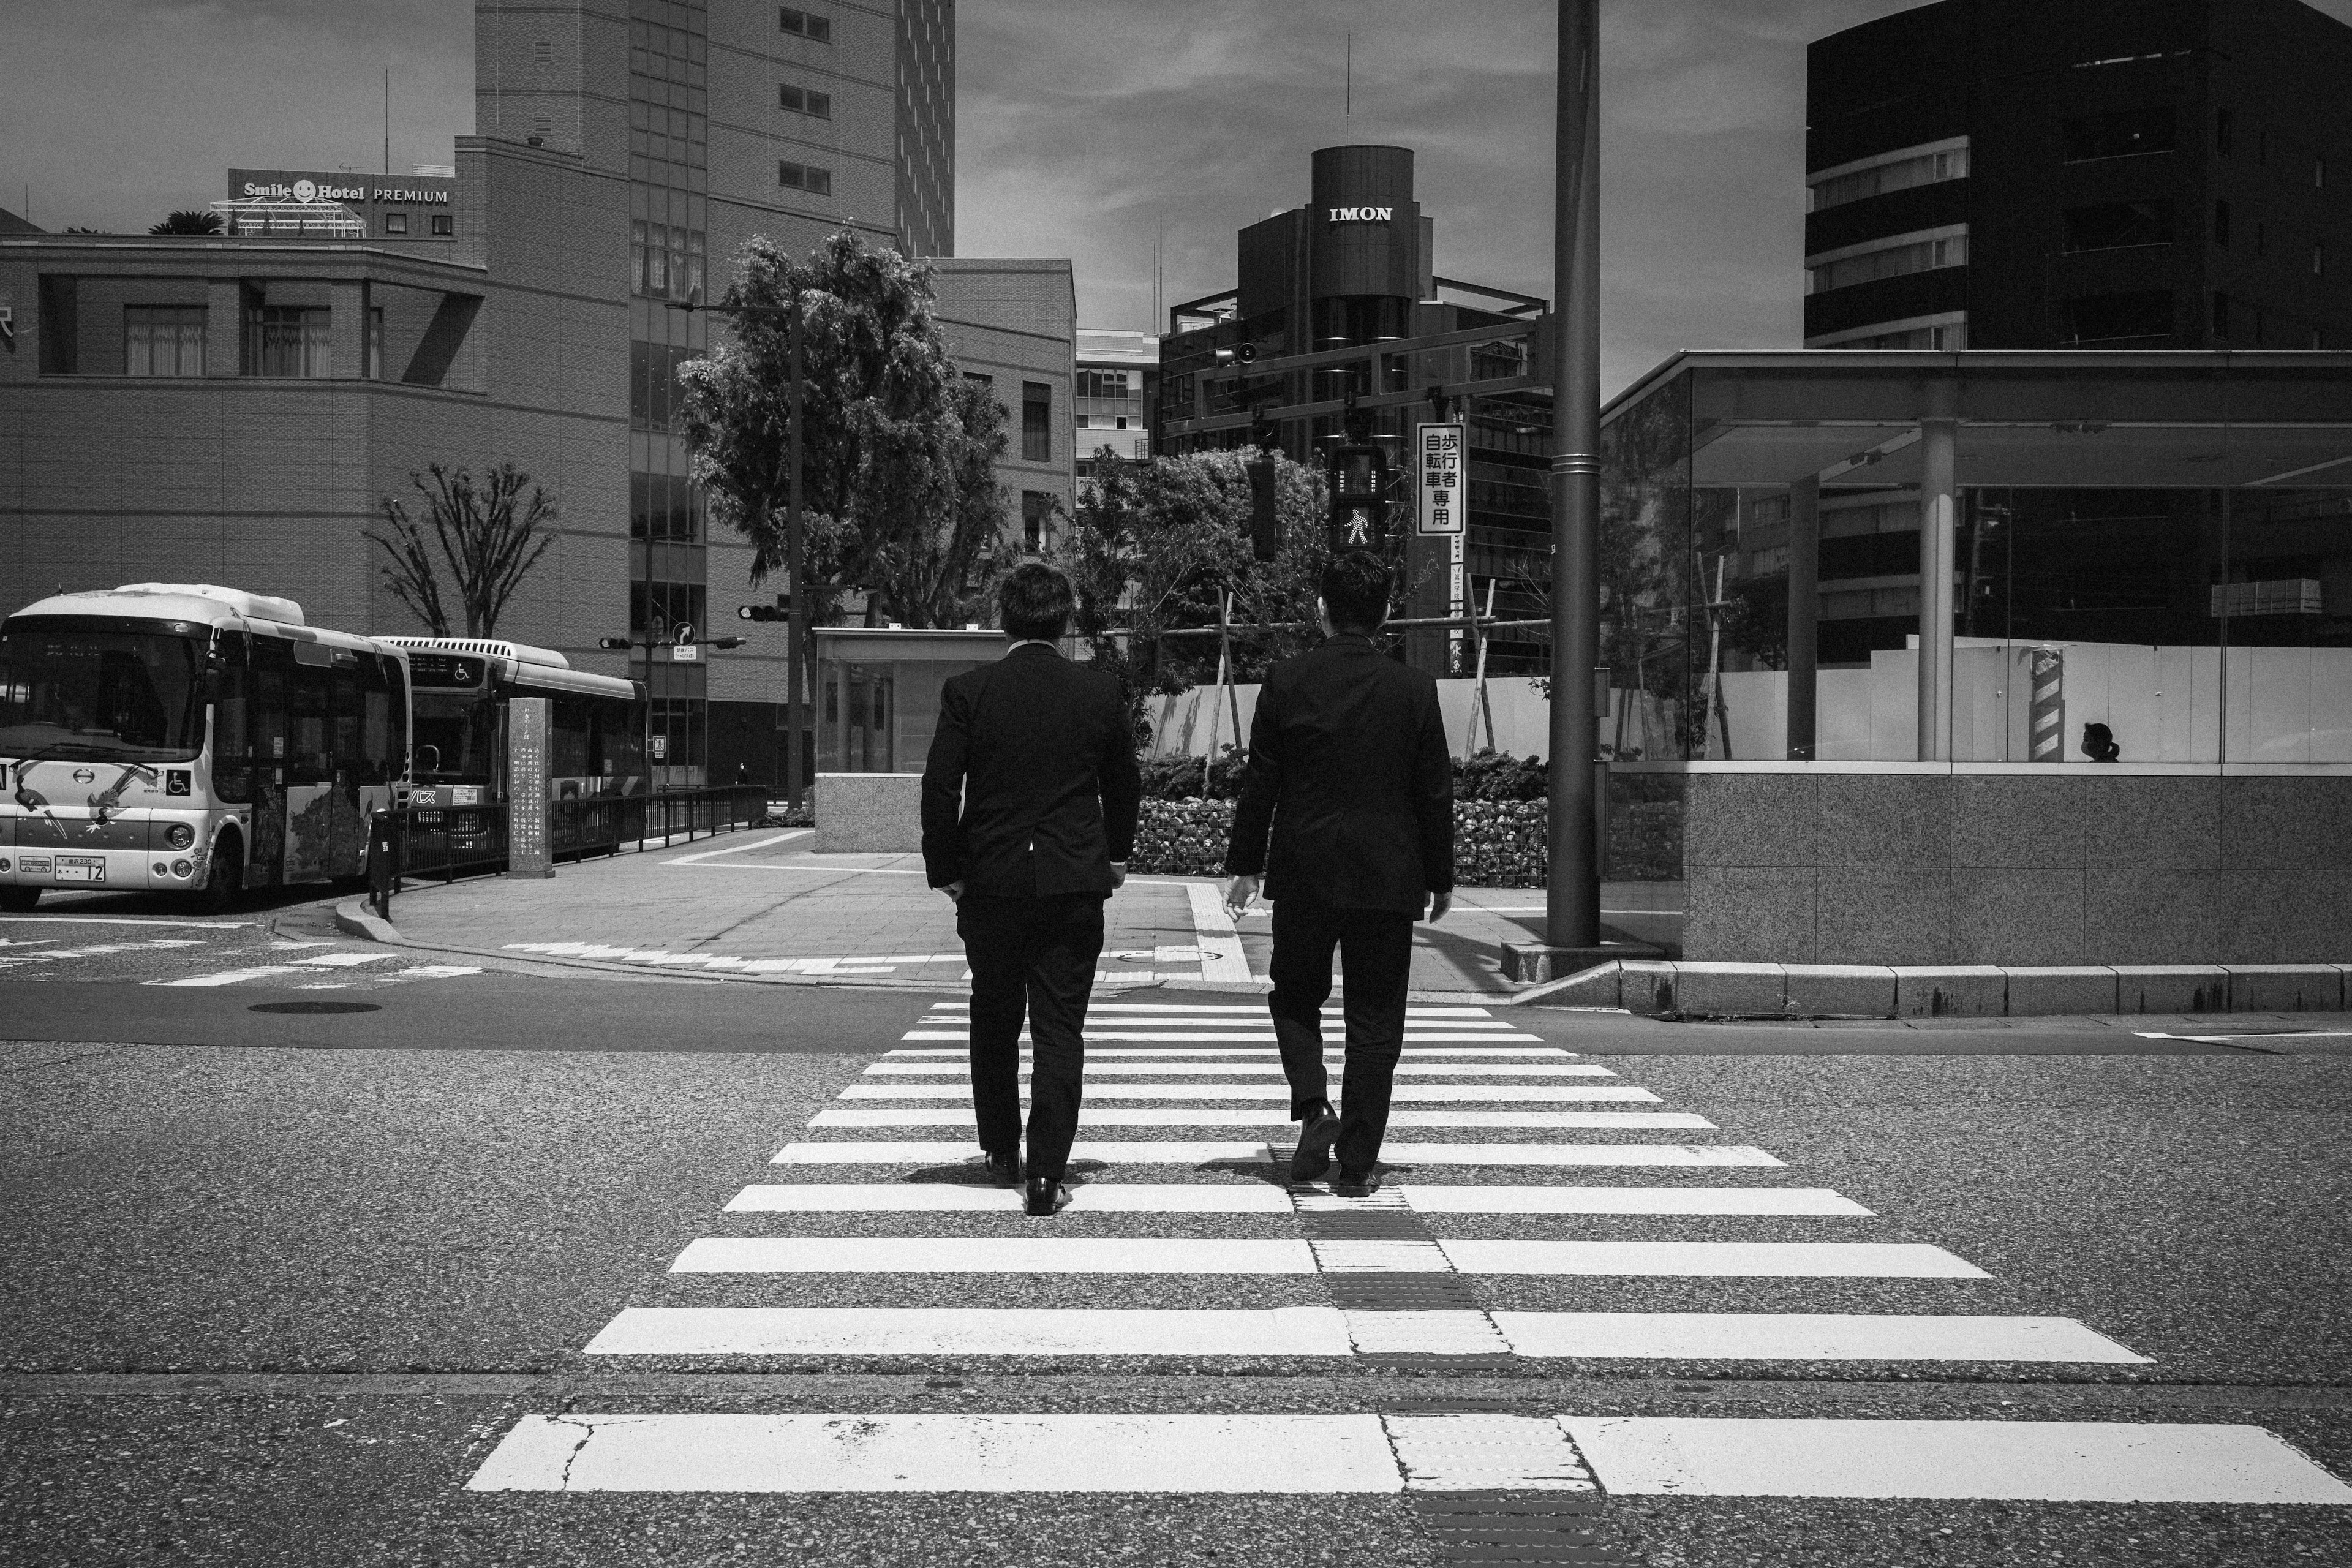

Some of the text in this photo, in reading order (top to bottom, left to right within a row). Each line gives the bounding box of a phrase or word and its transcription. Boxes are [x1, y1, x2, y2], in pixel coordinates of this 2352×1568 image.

[244, 183, 448, 202] Smile Hotel PREMIUM
[1329, 206, 1393, 222] IMON
[1425, 434, 1441, 488] 自転車
[1441, 434, 1458, 488] 歩行者
[1432, 489, 1450, 525] 専用
